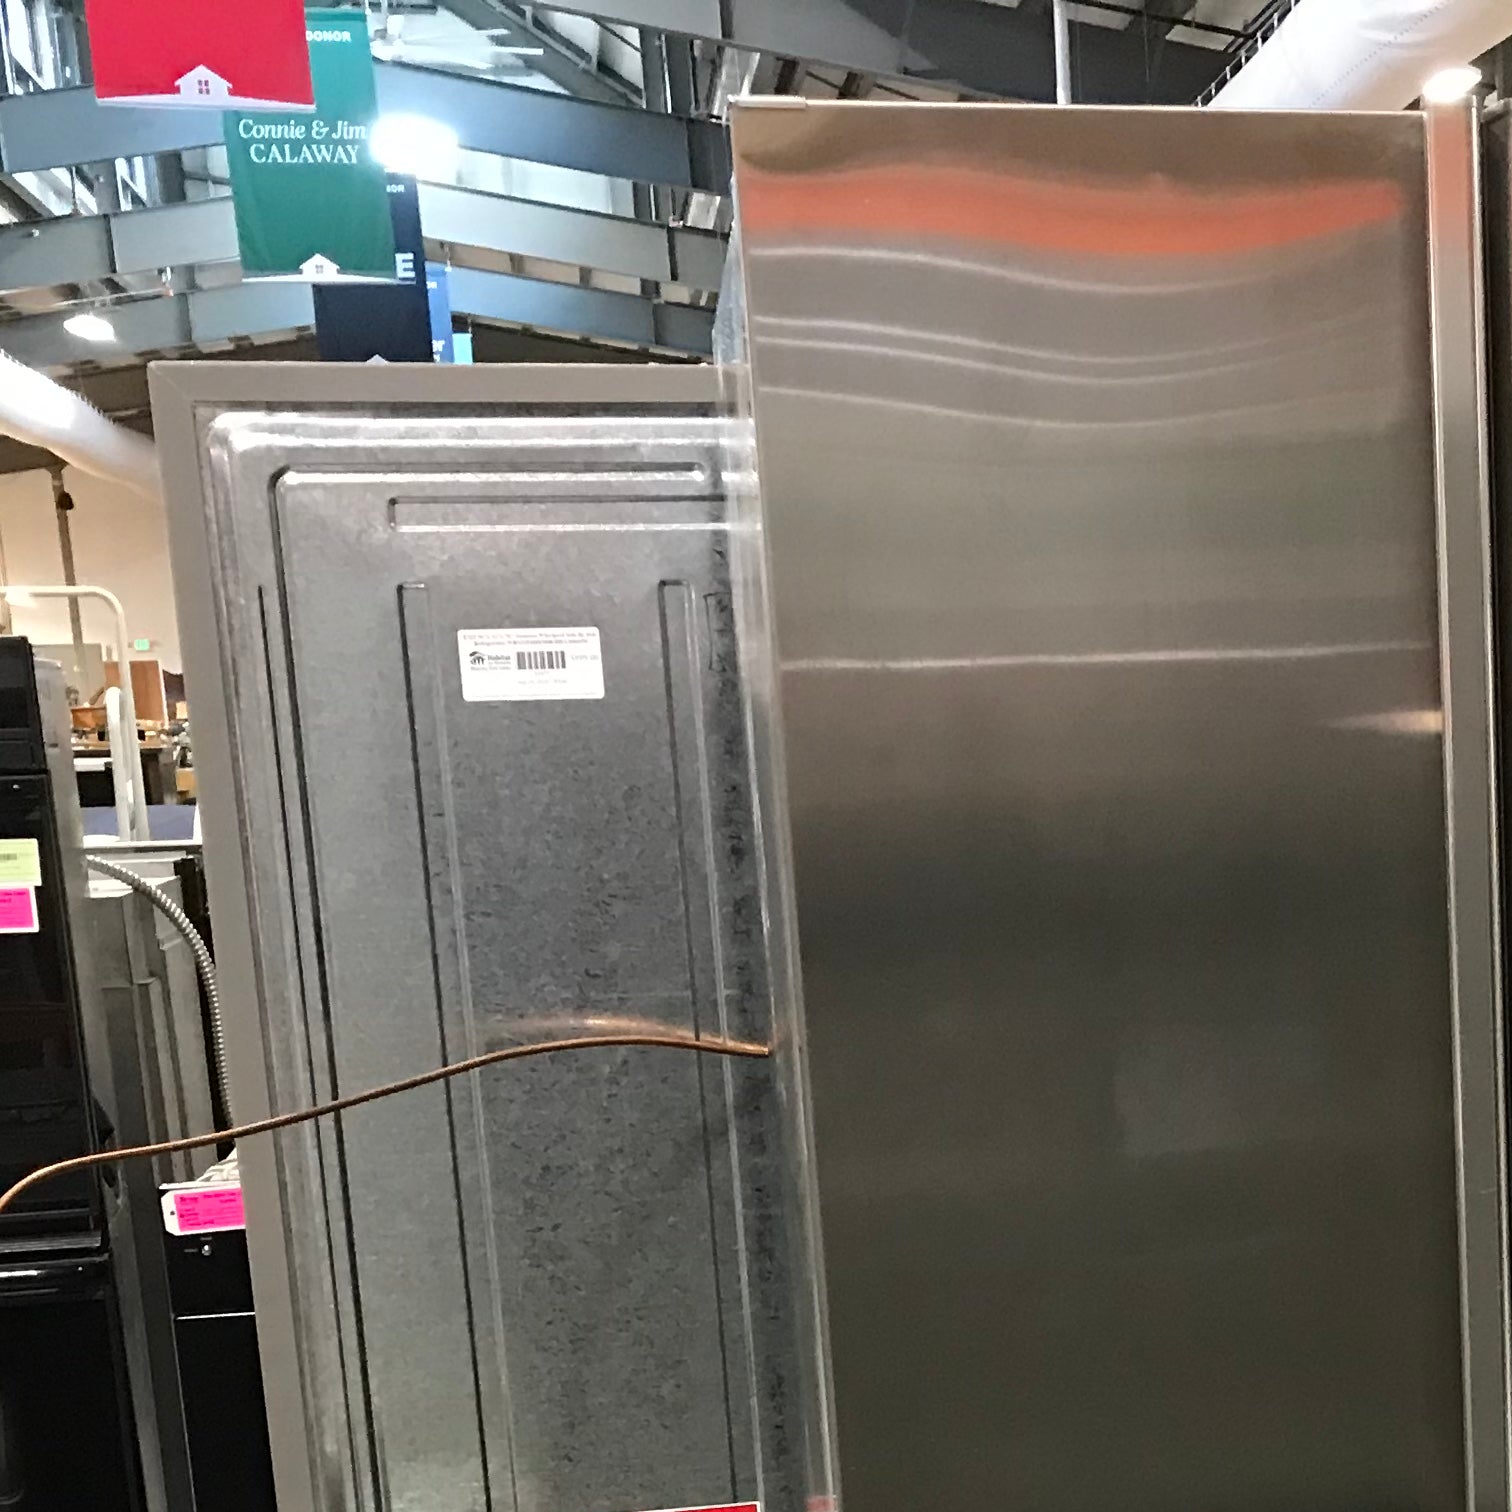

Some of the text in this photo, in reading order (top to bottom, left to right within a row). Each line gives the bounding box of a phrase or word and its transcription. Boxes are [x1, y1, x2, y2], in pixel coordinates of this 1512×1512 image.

[238, 118, 367, 140] Connie & Jim
[249, 143, 360, 164] CALAWAY
